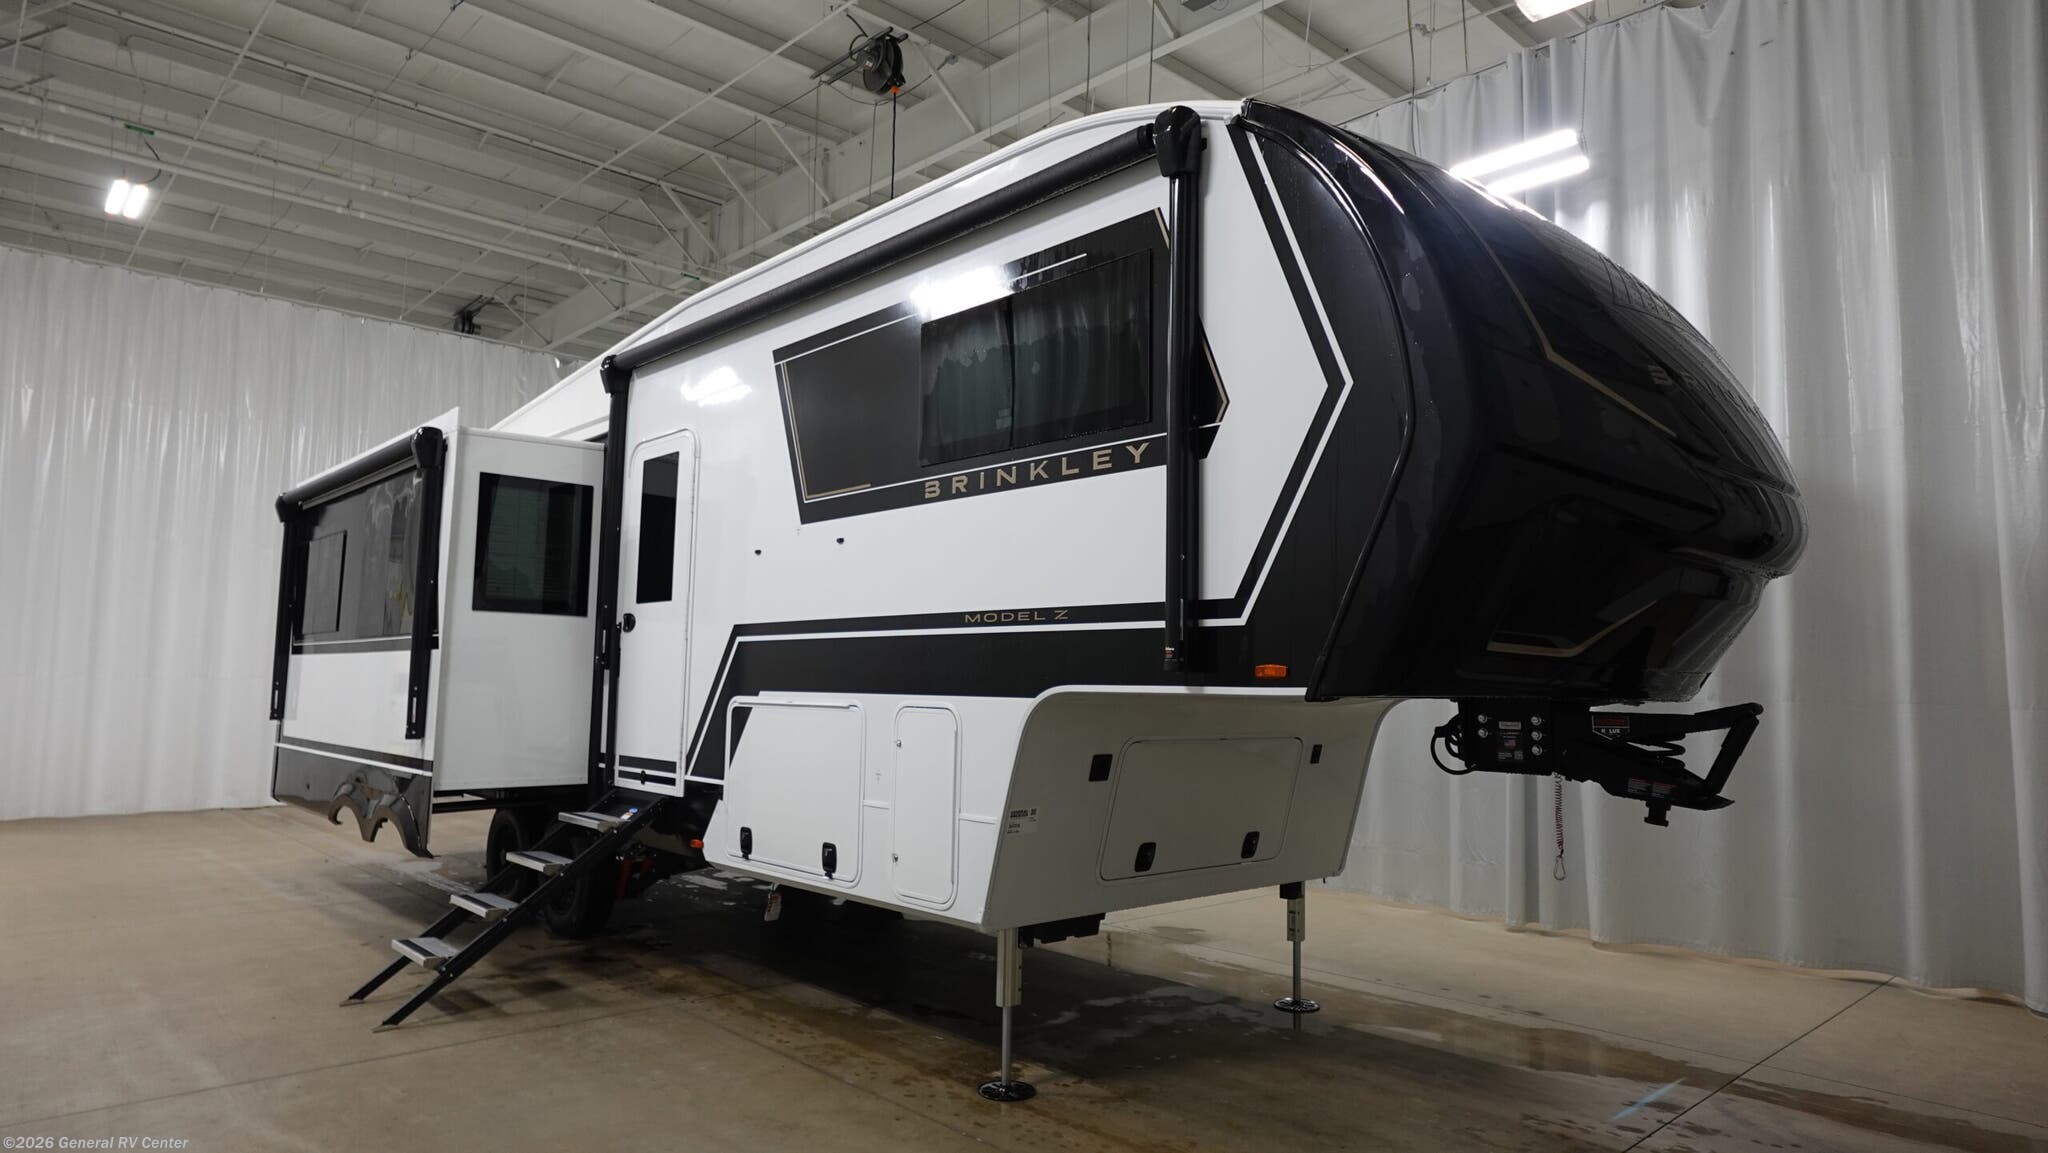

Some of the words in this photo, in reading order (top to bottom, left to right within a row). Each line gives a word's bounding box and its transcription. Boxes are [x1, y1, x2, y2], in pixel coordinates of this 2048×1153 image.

[924, 442, 1150, 499] BRINKLEY
[964, 610, 1046, 624] MODEL
[1054, 608, 1069, 620] Z
